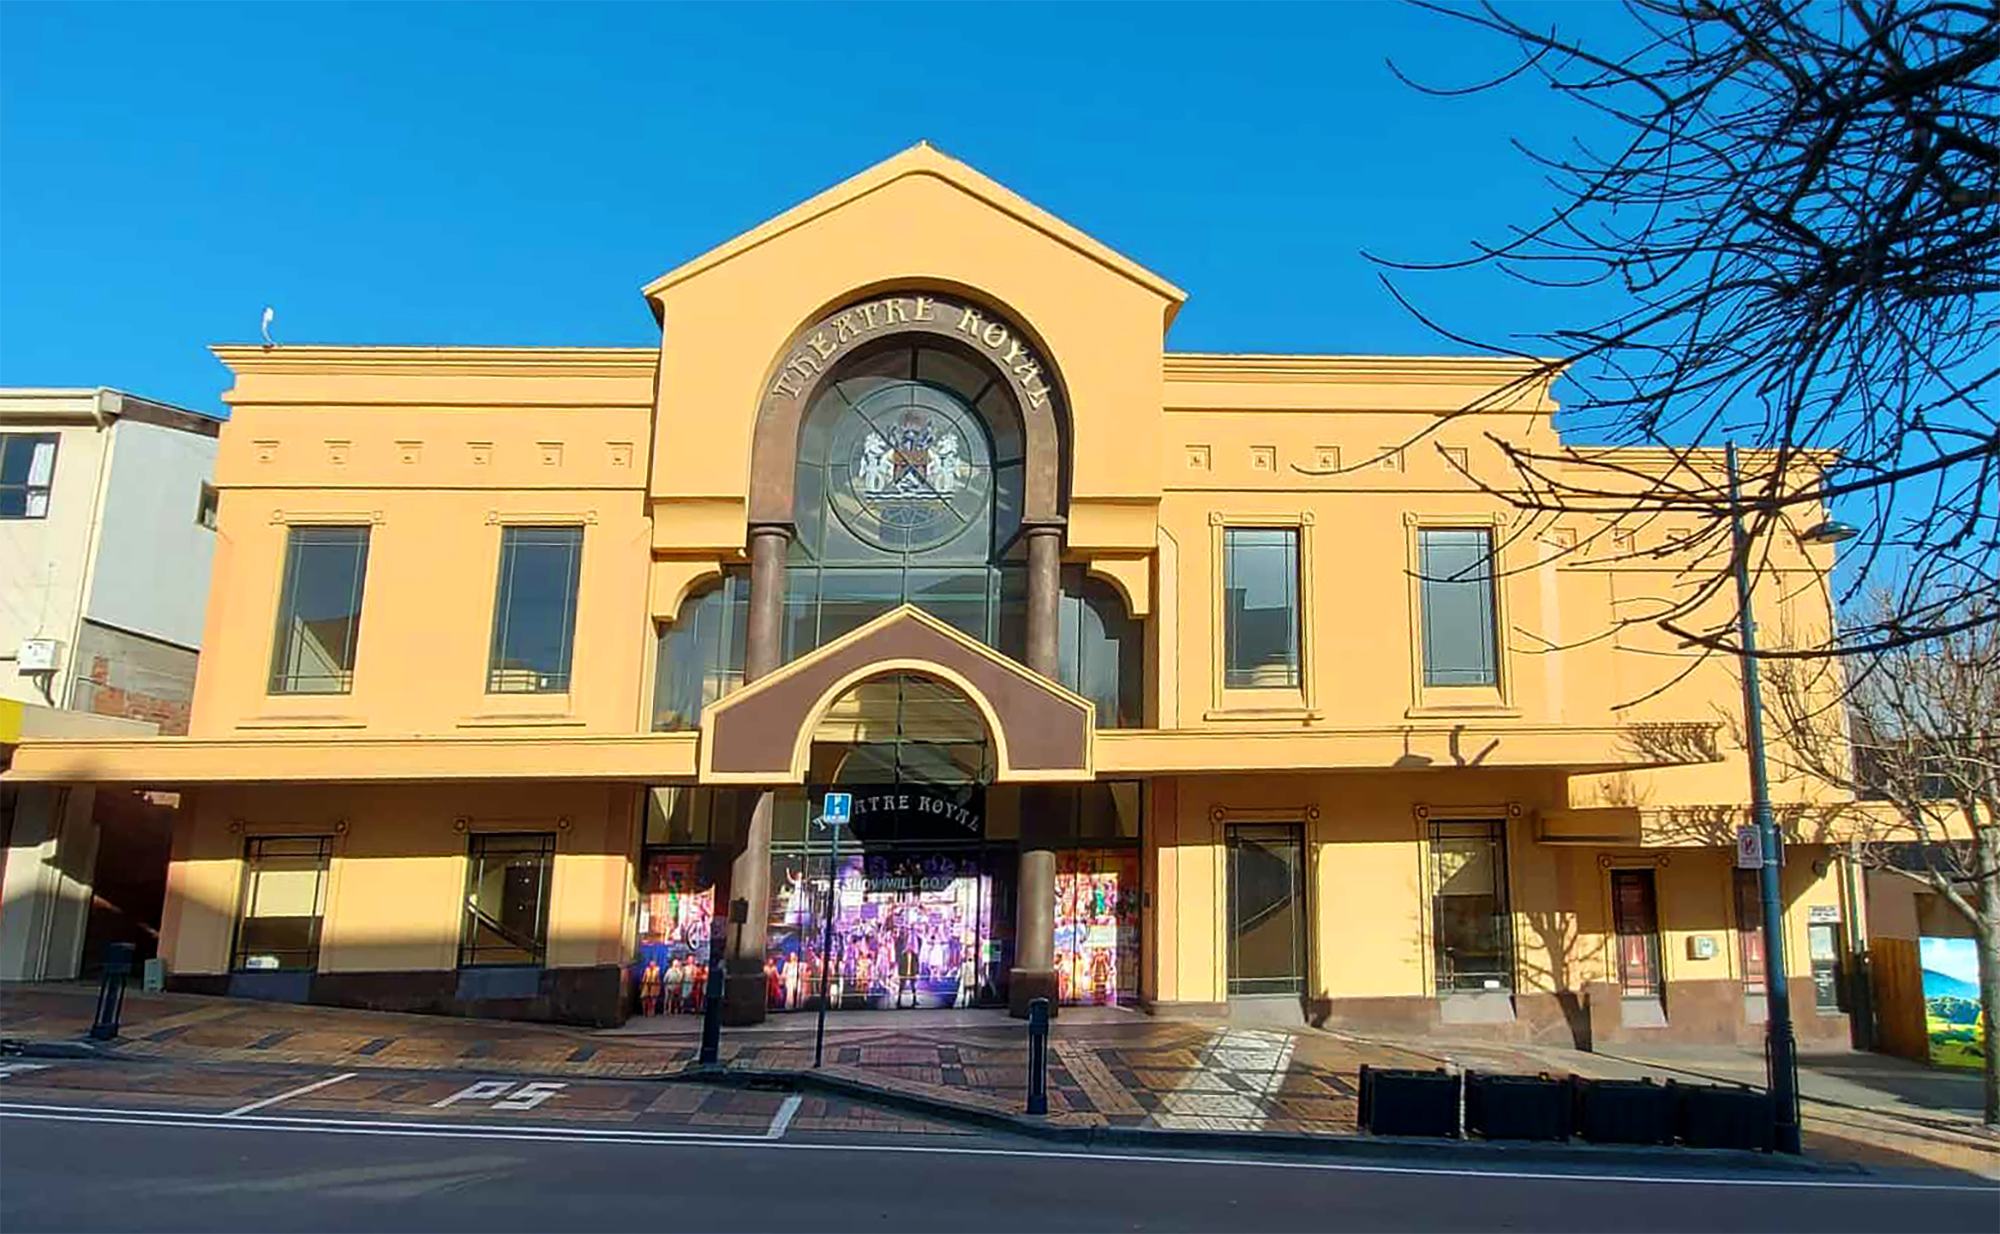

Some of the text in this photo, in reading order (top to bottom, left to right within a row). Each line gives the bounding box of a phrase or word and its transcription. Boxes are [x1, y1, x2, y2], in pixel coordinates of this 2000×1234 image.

[772, 296, 1051, 409] THEATRE ROYAL
[812, 795, 910, 831] TATRE
[918, 796, 981, 832] ROYAL
